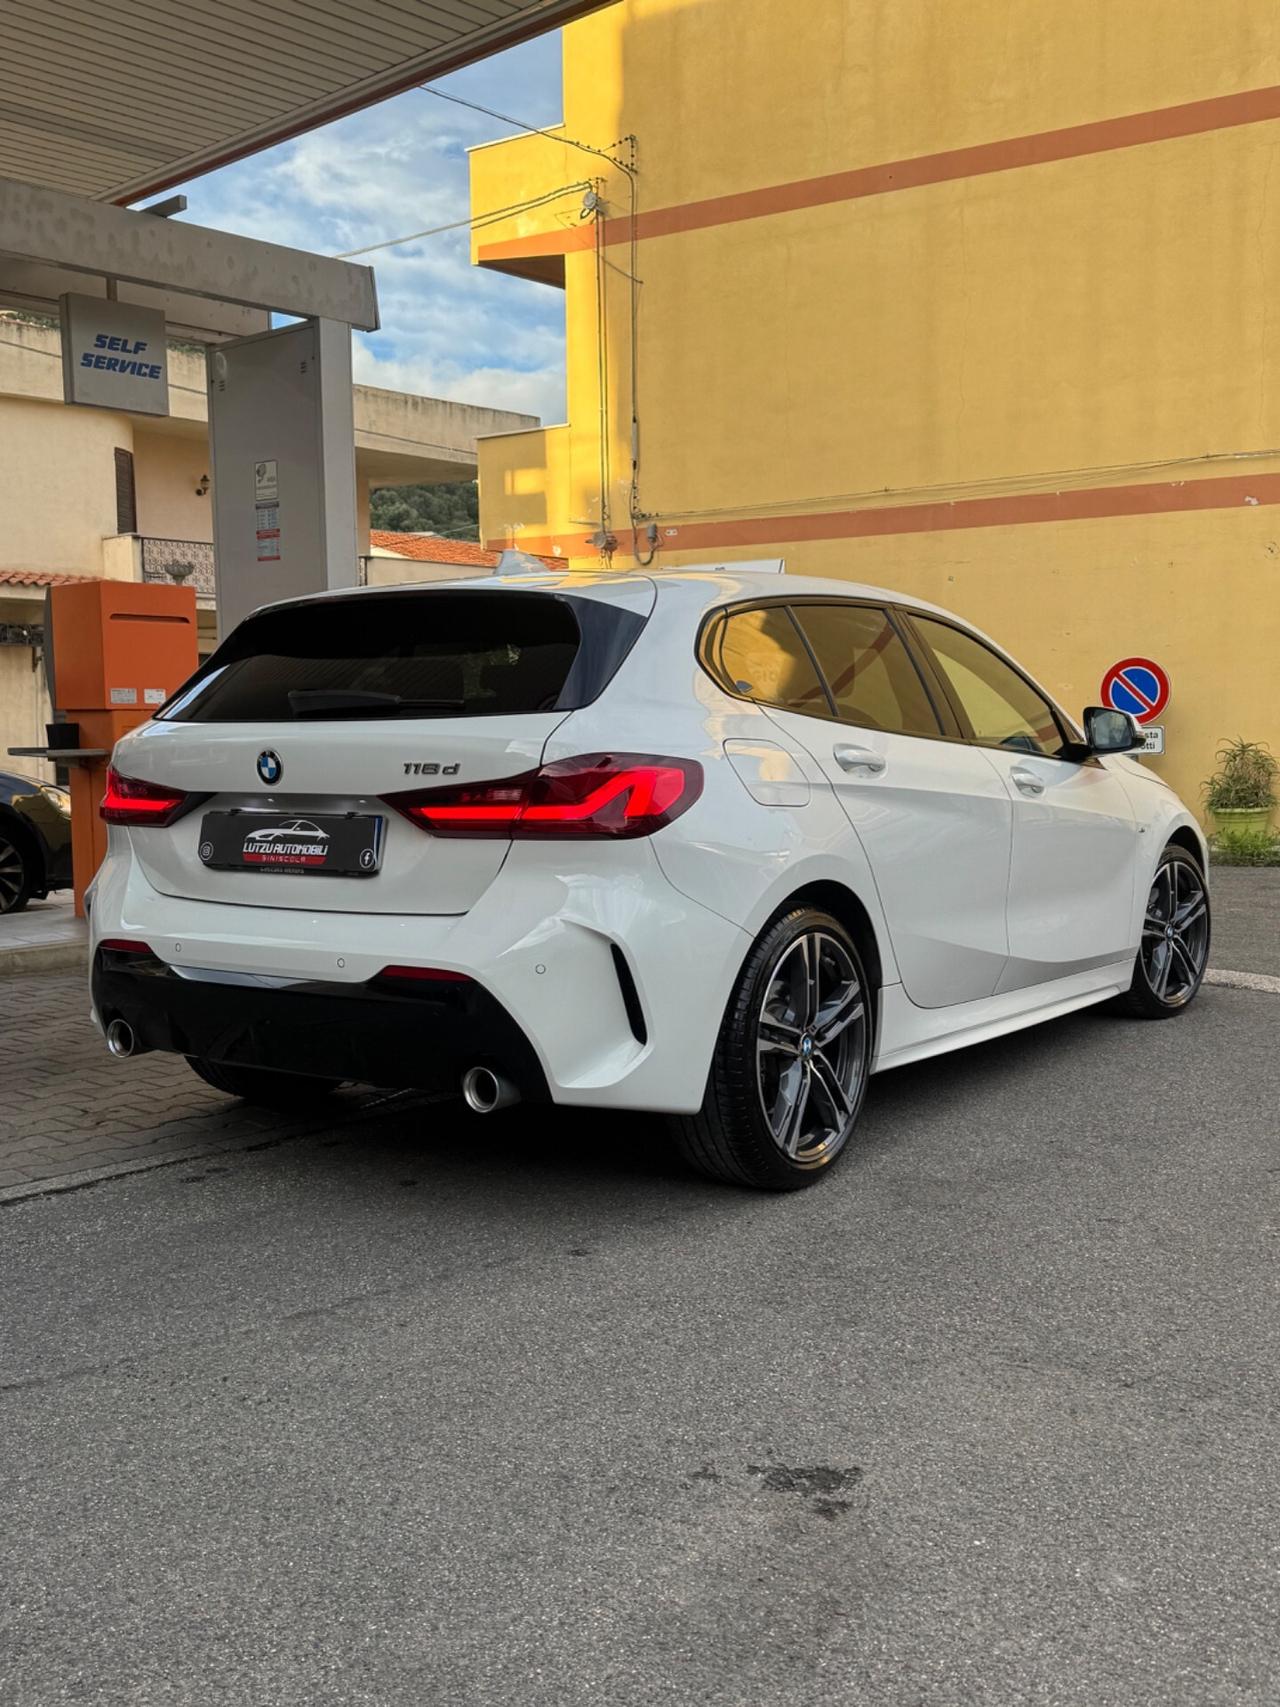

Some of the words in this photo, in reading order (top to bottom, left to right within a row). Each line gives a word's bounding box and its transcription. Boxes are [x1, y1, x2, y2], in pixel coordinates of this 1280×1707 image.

[94, 333, 148, 354] SELF
[80, 352, 162, 379] SERVICE
[403, 762, 460, 775] 118d
[243, 842, 273, 854] LUTZU
[272, 843, 328, 856] AUTOMOBILI
[262, 855, 306, 864] SINISCOLA
